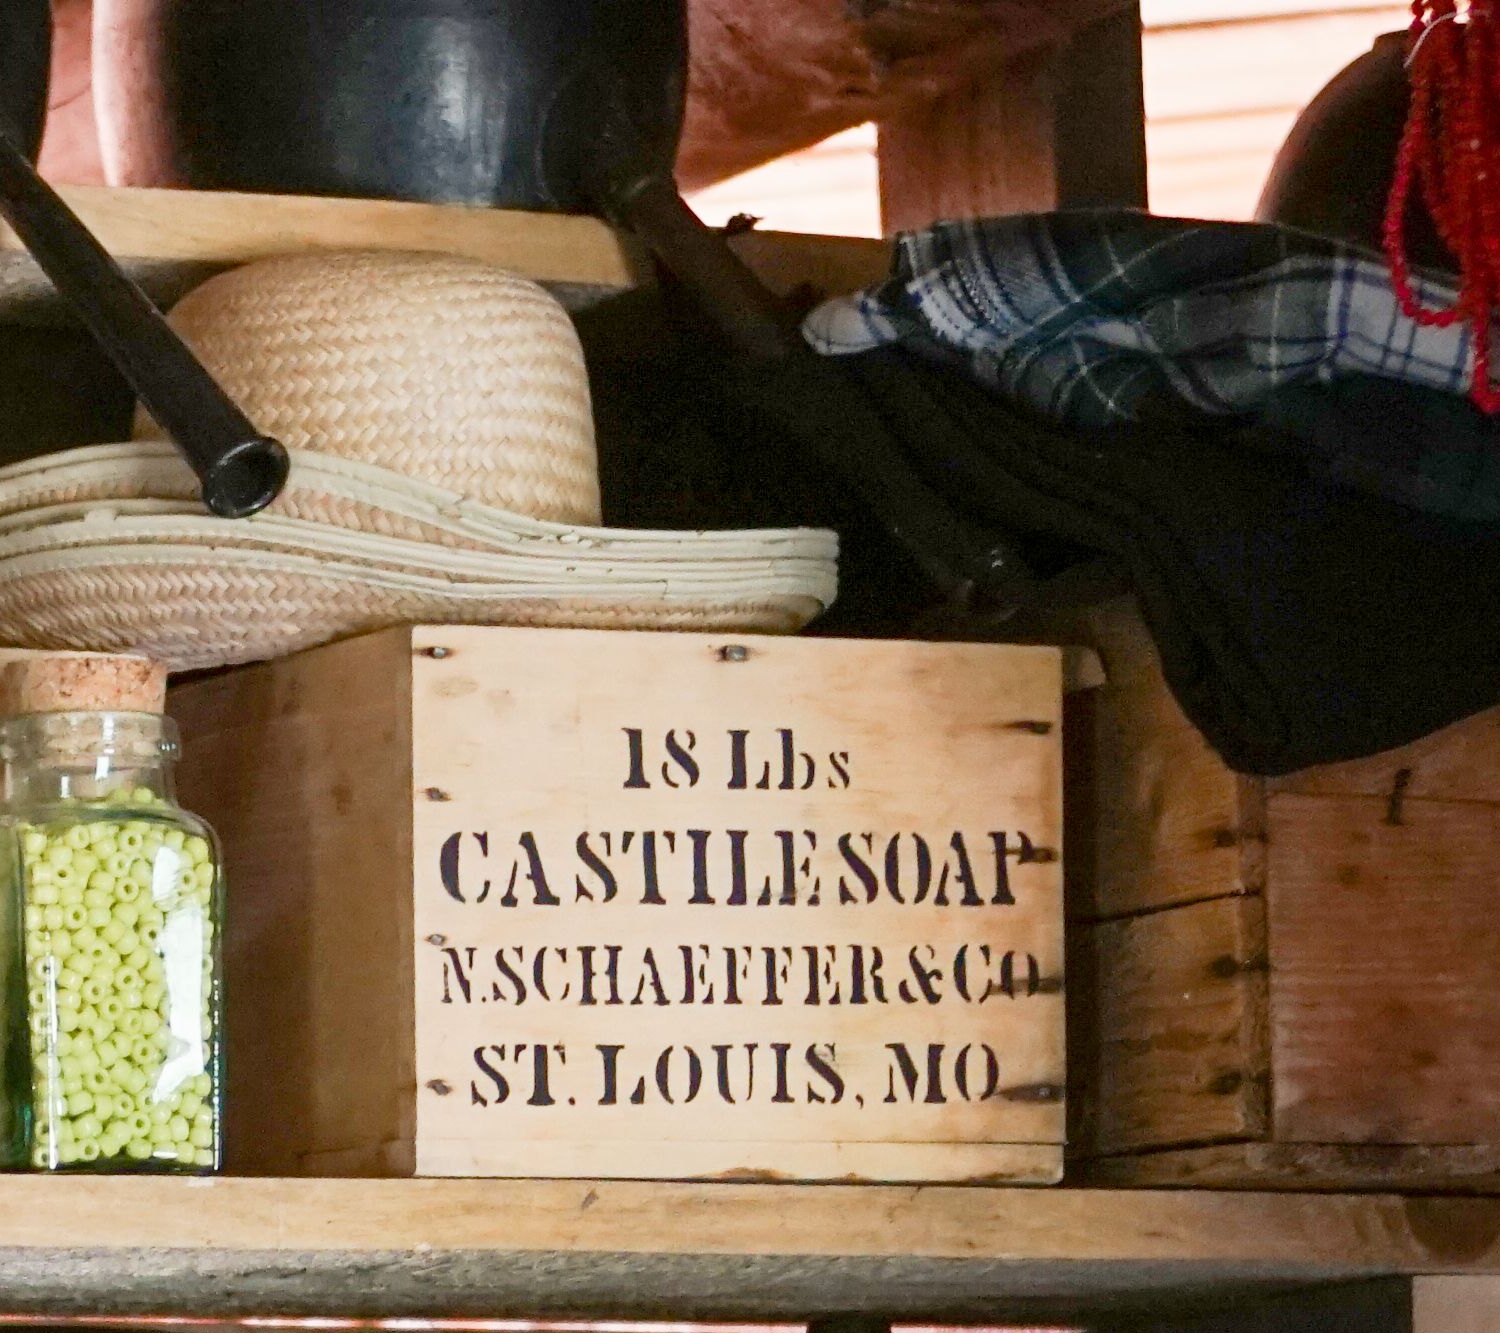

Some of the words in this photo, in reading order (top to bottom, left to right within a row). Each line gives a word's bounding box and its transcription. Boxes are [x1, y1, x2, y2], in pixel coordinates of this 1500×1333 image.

[621, 726, 701, 789] 18
[726, 727, 852, 791] Lbs
[438, 829, 821, 908] CASTILE
[837, 829, 1034, 908] SOAP
[470, 1042, 578, 1108] ST.
[596, 1042, 866, 1112] LOUIS,
[883, 1042, 1001, 1106] MO
